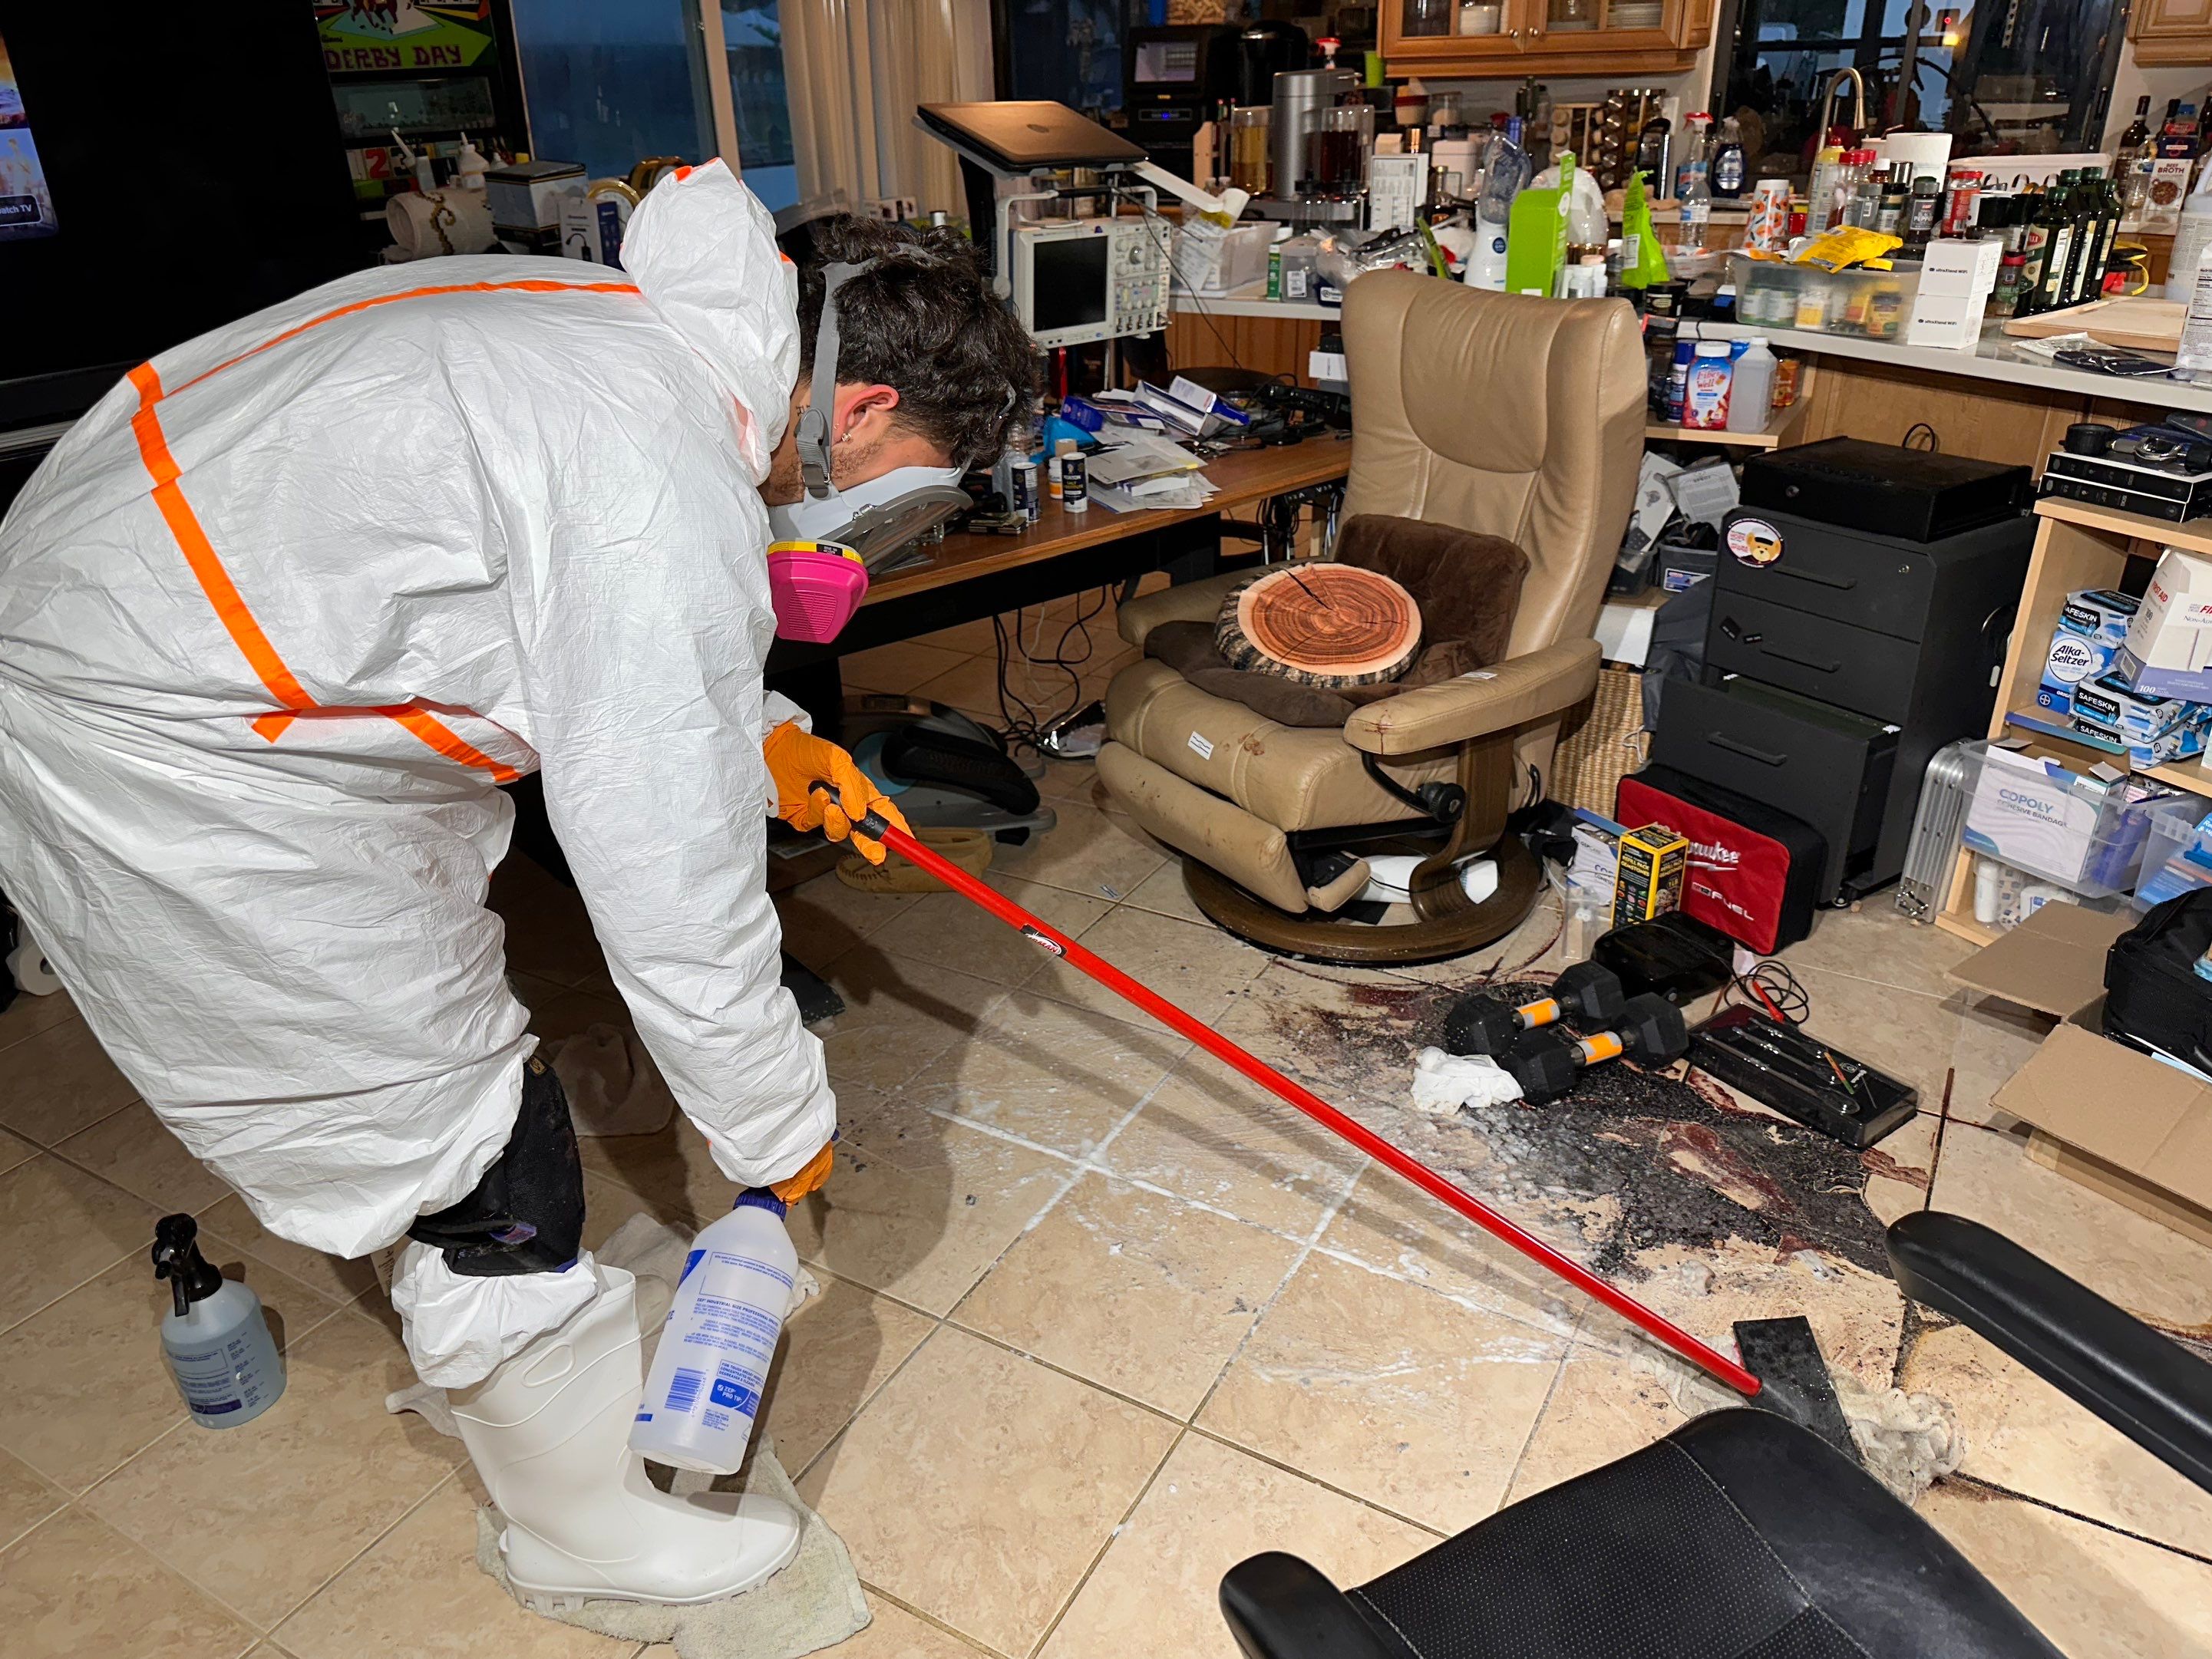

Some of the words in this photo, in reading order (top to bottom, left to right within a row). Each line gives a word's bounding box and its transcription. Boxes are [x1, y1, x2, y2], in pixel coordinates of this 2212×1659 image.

[325, 46, 401, 71] DERBY
[413, 45, 462, 66] DAY
[366, 149, 390, 180] 2
[0, 206, 19, 214] atch
[2158, 591, 2168, 602] AID
[2065, 606, 2098, 622] AFESKIN
[2055, 645, 2085, 657] Alka-
[2050, 653, 2090, 667] Seltzer
[2139, 684, 2156, 693] 100
[2078, 692, 2116, 712] SAFESKIN
[2080, 725, 2118, 744] SAFESKIN
[1999, 788, 2054, 813] COPOLY
[1621, 860, 1650, 876] GEMSTONES
[1636, 862, 1649, 871] PACK
[1712, 891, 1755, 921] FUEL
[706, 1298, 731, 1307] INDUSTRIAL
[742, 1305, 768, 1321] PROFESSIONAL
[718, 1370, 740, 1380] DEGREASER
